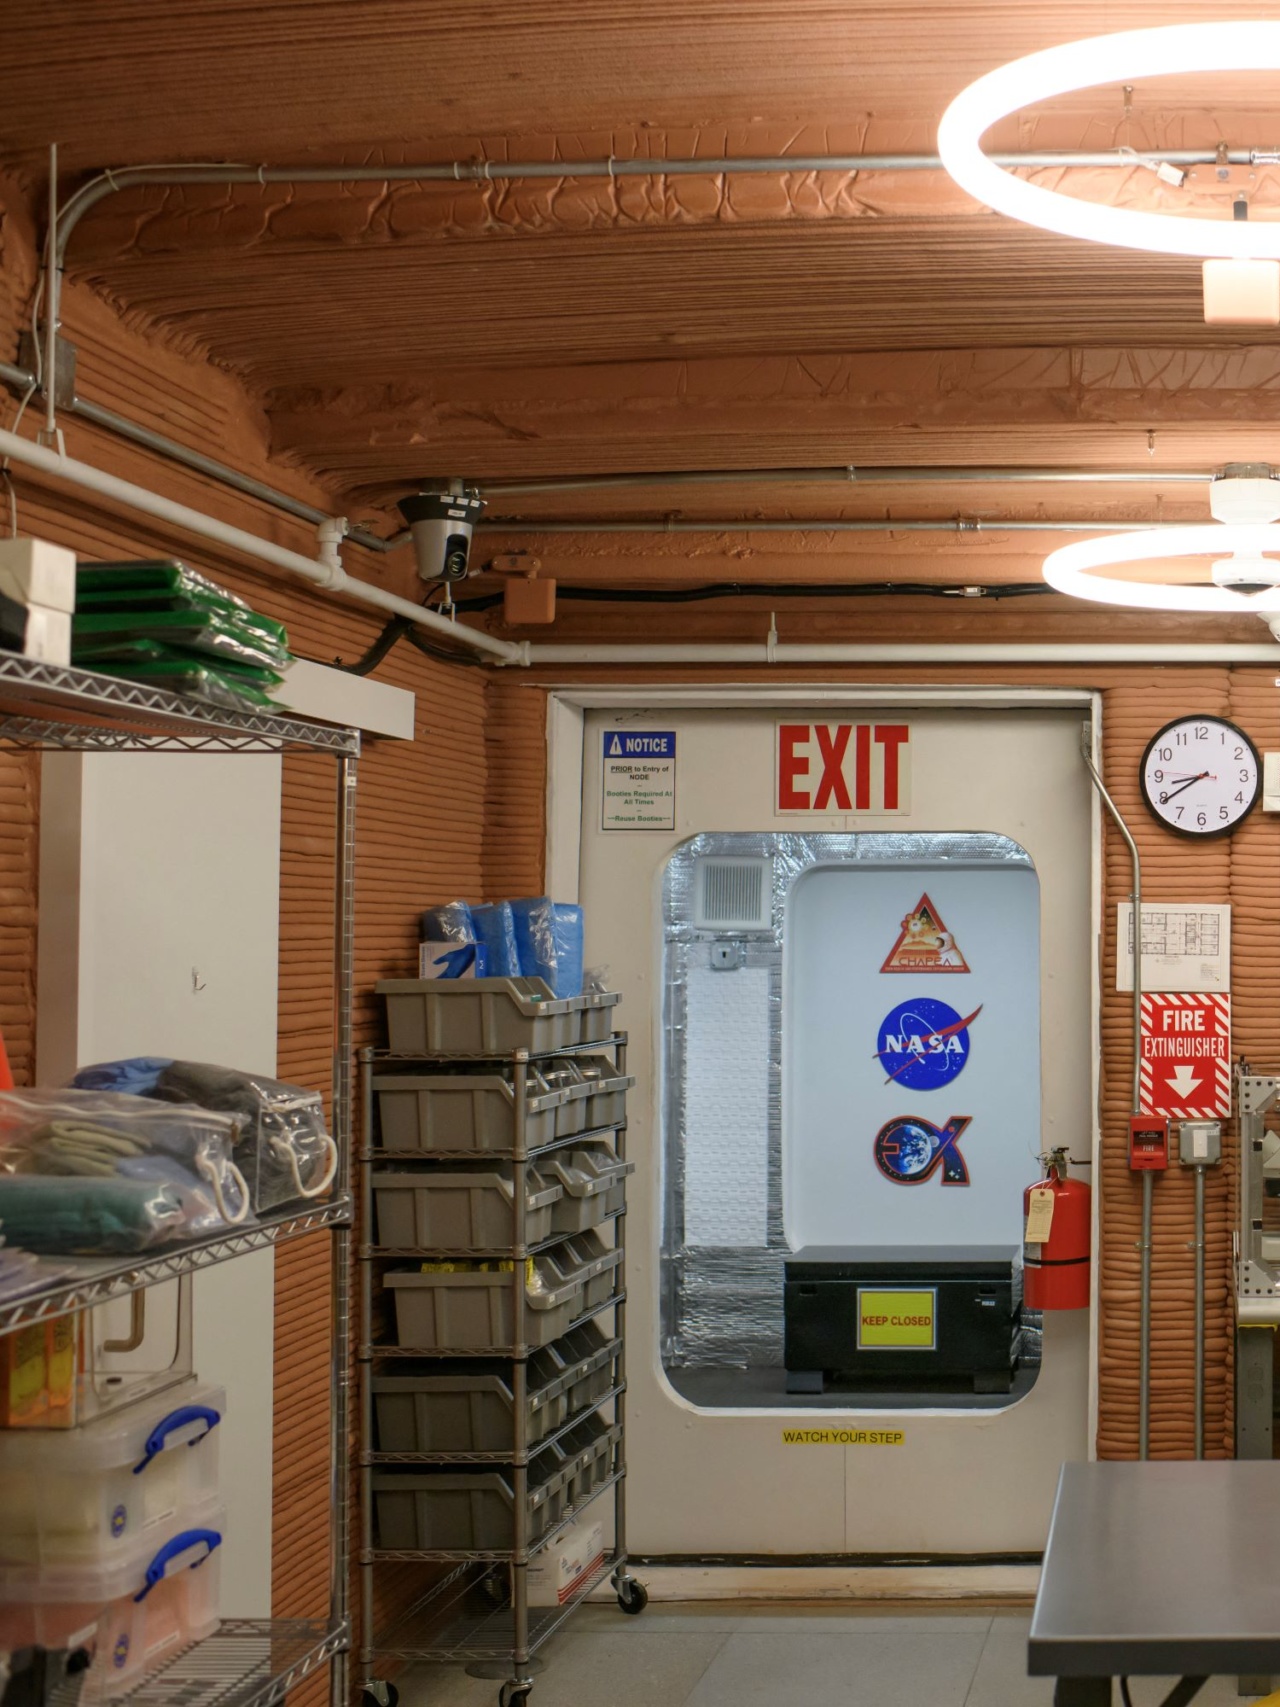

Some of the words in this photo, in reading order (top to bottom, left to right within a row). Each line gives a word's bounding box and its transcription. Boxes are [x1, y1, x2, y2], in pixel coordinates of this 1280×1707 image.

[1176, 732, 1187, 746] 11
[1194, 726, 1208, 740] 12
[1220, 732, 1225, 745] 1
[626, 738, 667, 752] NOTICE
[1158, 748, 1173, 762] 10
[1234, 747, 1244, 760] 2
[779, 725, 909, 809] EXIT
[1154, 769, 1164, 783] 9
[1239, 769, 1249, 782] 3
[1159, 791, 1168, 805] 8
[1234, 791, 1243, 804] 4
[1175, 806, 1185, 820] 7
[1197, 812, 1206, 826] 6
[1218, 806, 1228, 820] 5
[898, 957, 951, 967] CHAPEA
[1162, 1010, 1205, 1031] FIRE
[885, 1035, 965, 1053] NASA
[1144, 1037, 1225, 1058] EXTINGUISHER
[862, 1316, 888, 1326] KEEP
[890, 1316, 931, 1326] CLOSED
[783, 1432, 828, 1443] WATCH
[831, 1432, 867, 1443] YOUR
[869, 1432, 902, 1444] STEP
